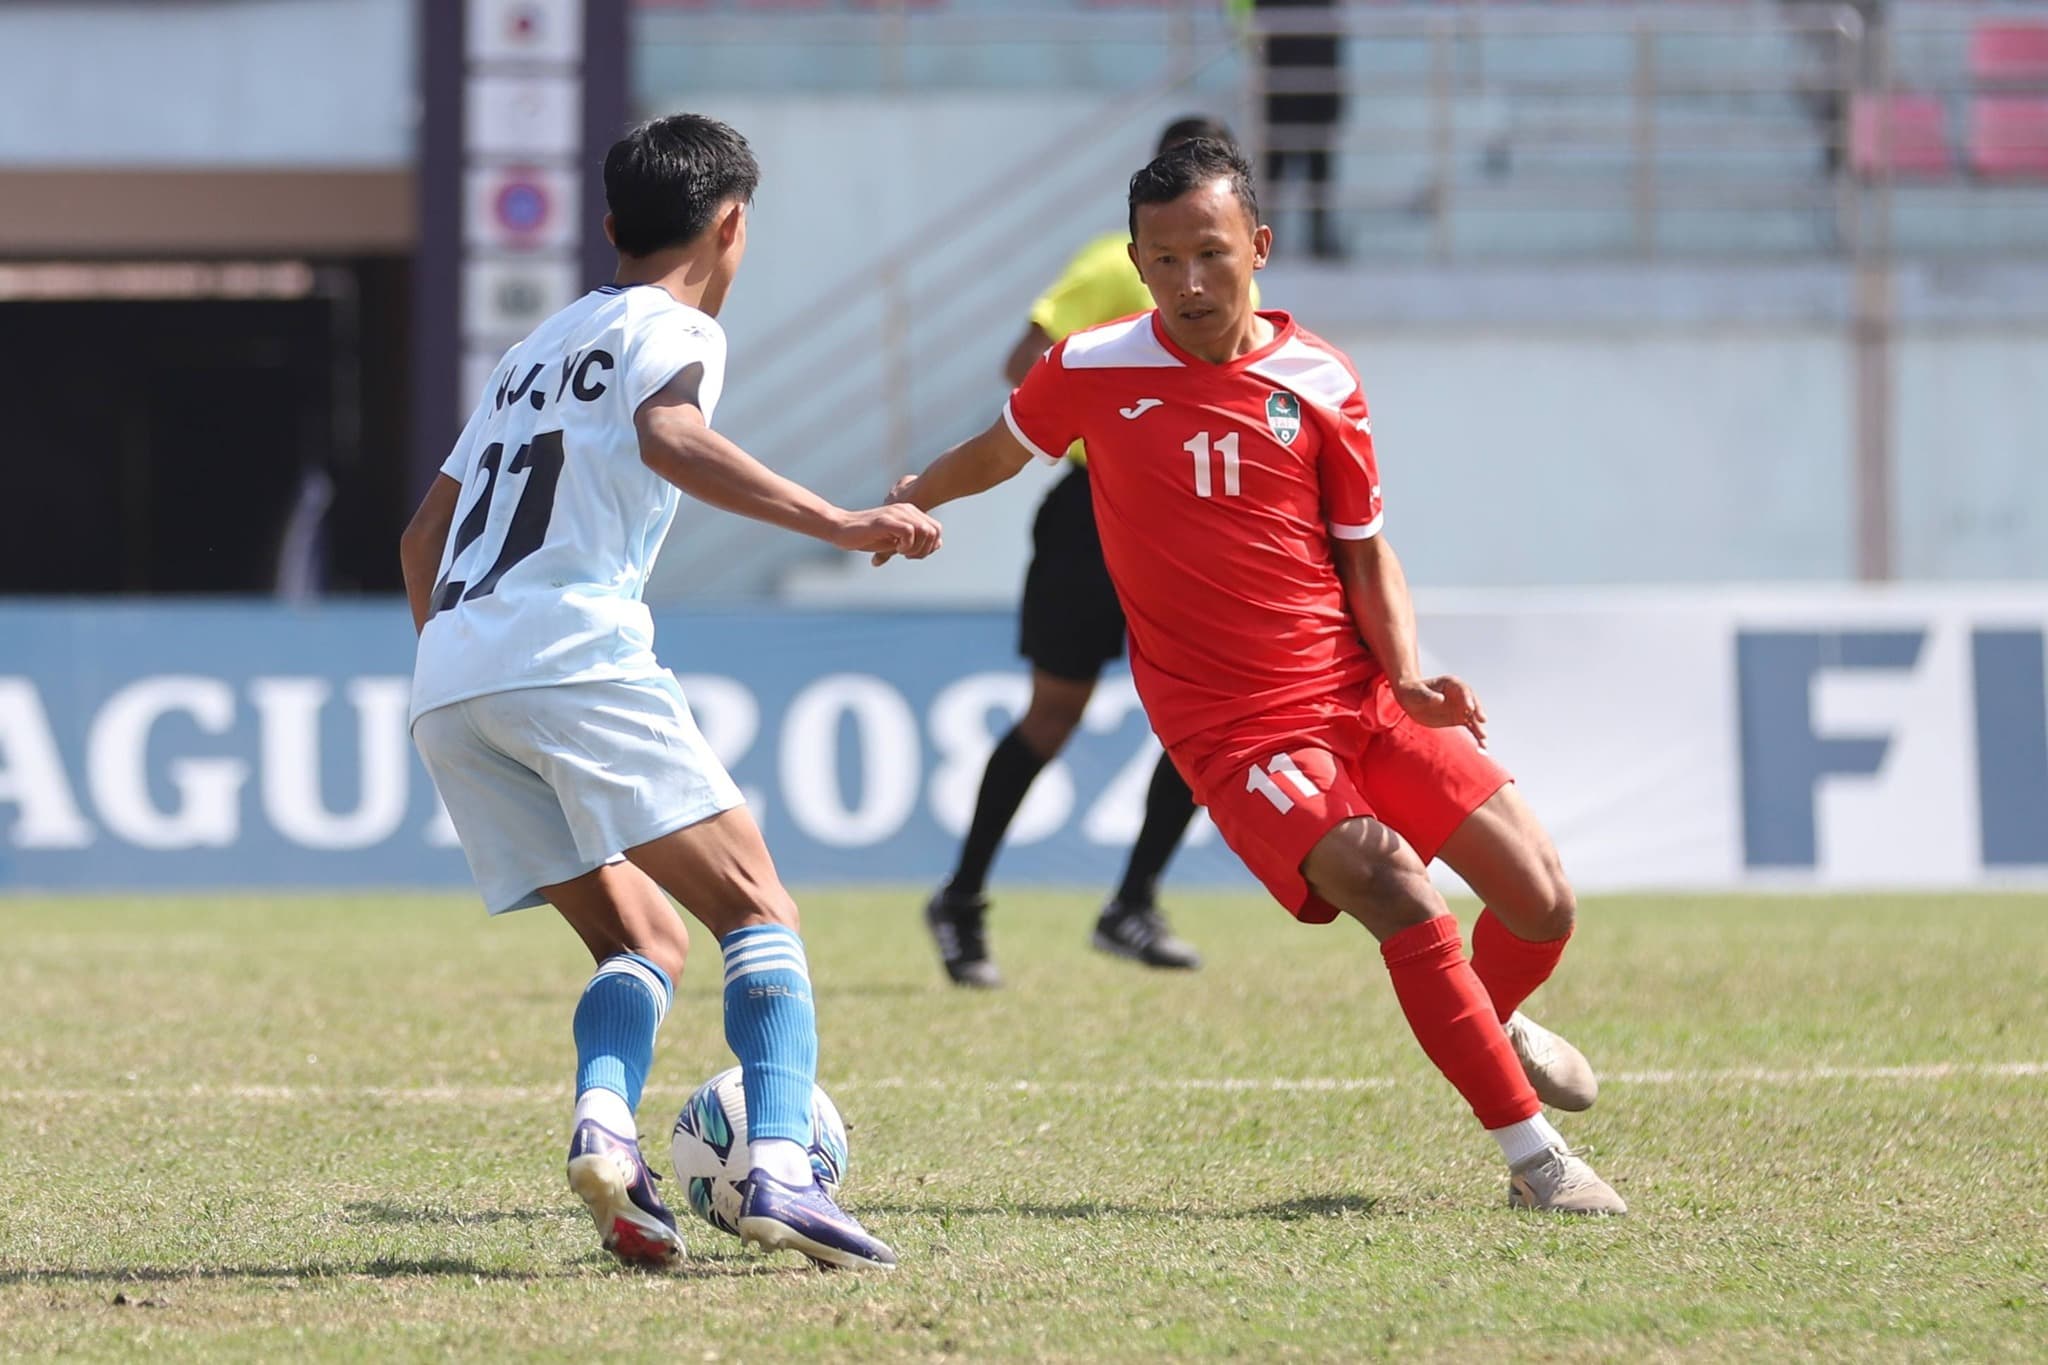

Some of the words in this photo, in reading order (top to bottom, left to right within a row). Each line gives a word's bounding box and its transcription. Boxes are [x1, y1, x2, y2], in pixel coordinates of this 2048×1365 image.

[1183, 431, 1240, 497] 11
[0, 675, 462, 850] AGU
[1246, 752, 1320, 815] 11
